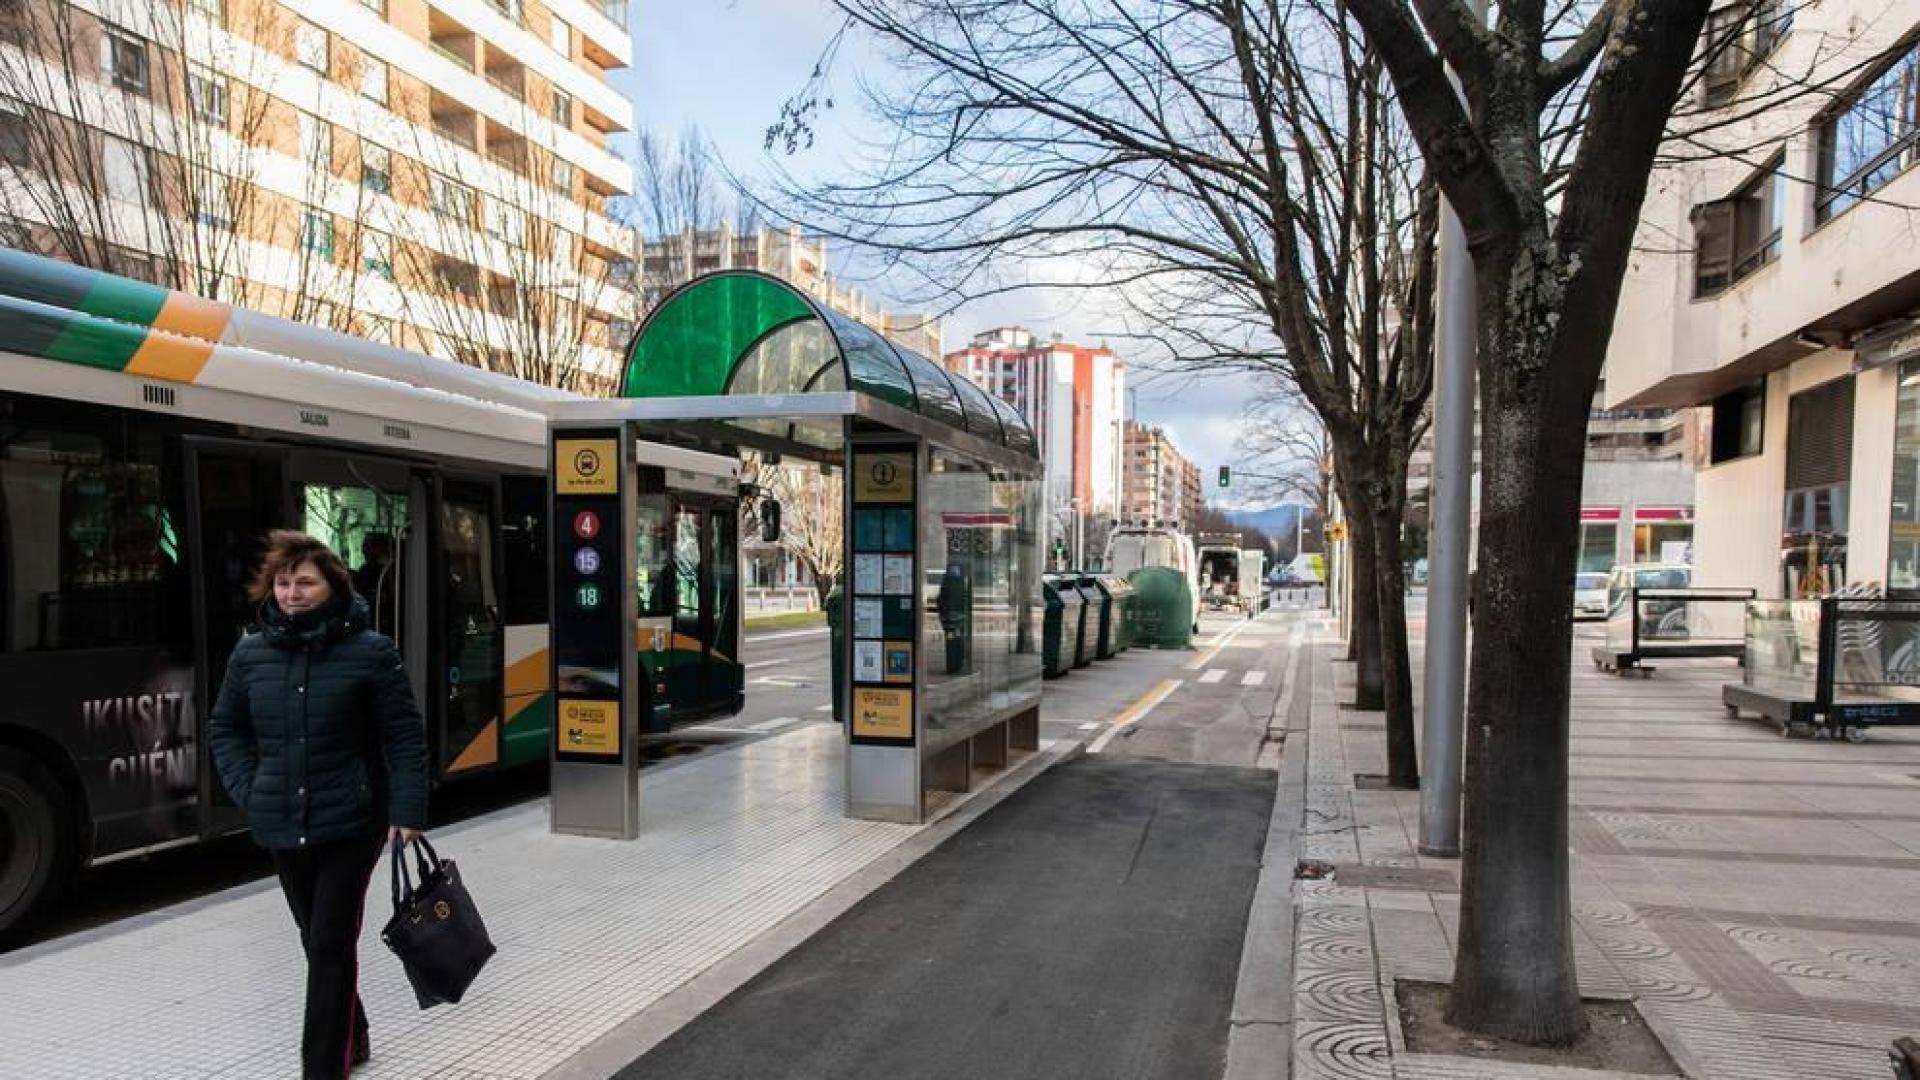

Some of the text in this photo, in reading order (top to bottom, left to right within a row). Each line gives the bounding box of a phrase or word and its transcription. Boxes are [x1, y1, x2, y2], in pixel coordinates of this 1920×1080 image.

[581, 516, 592, 534] 4
[578, 550, 596, 571] 15
[579, 588, 597, 606] 18
